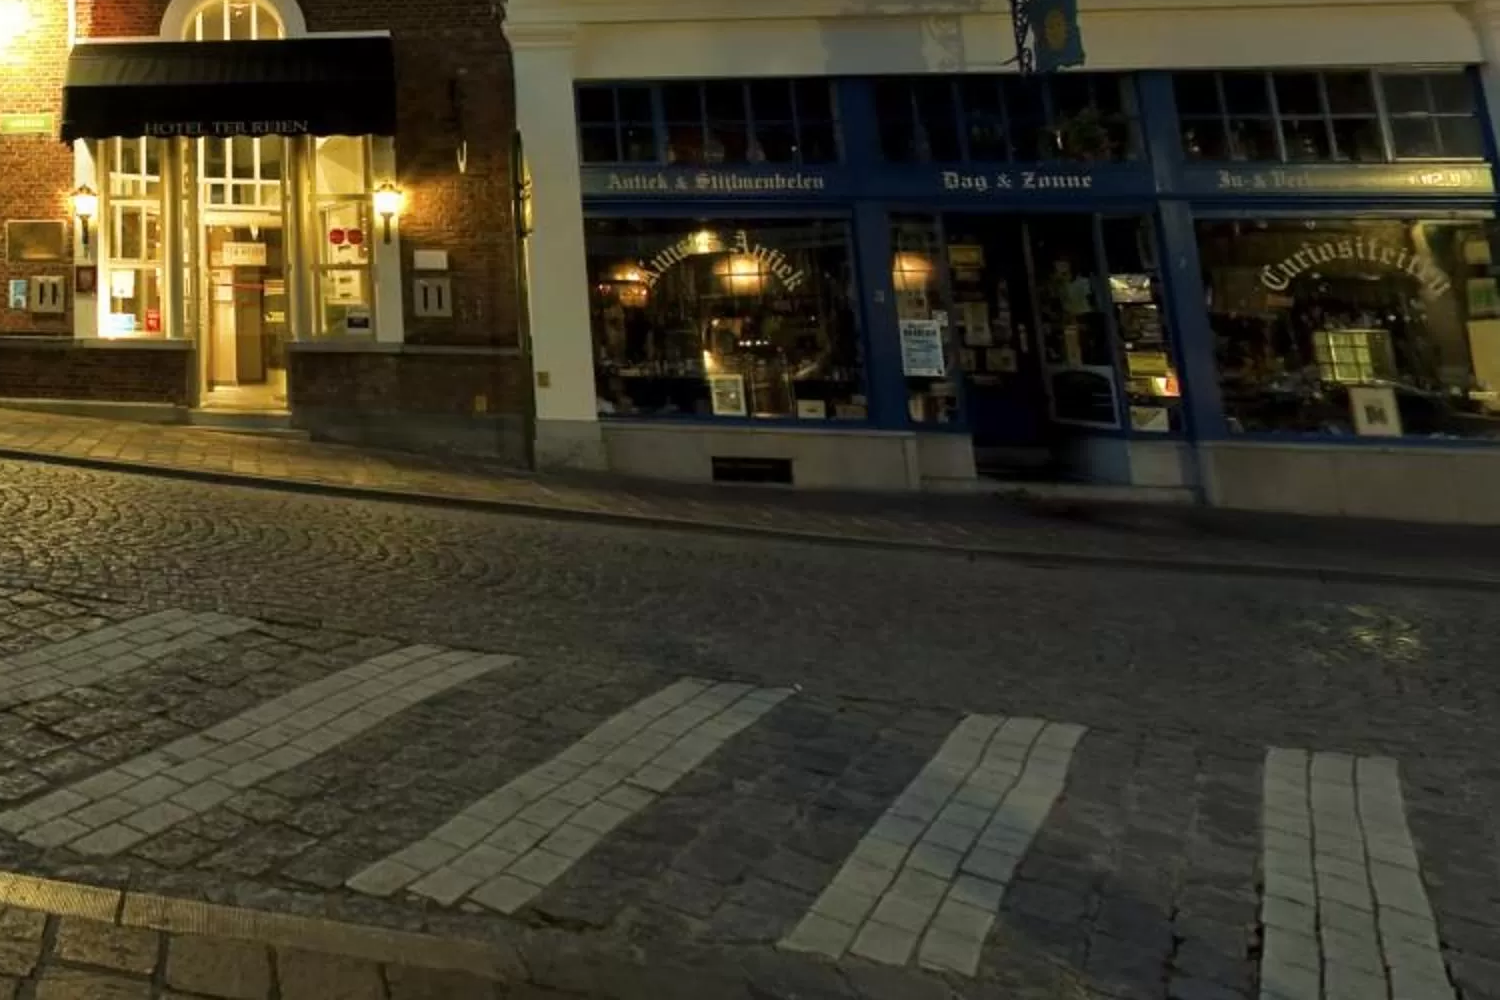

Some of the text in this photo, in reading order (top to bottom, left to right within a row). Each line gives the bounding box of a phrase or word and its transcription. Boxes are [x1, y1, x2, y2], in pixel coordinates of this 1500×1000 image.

[144, 119, 308, 135] HOTEL TER REIEN
[606, 172, 668, 190] Antiek
[674, 174, 689, 190] &
[939, 170, 1093, 192] Dag & Zonne
[729, 229, 804, 292] Antiek
